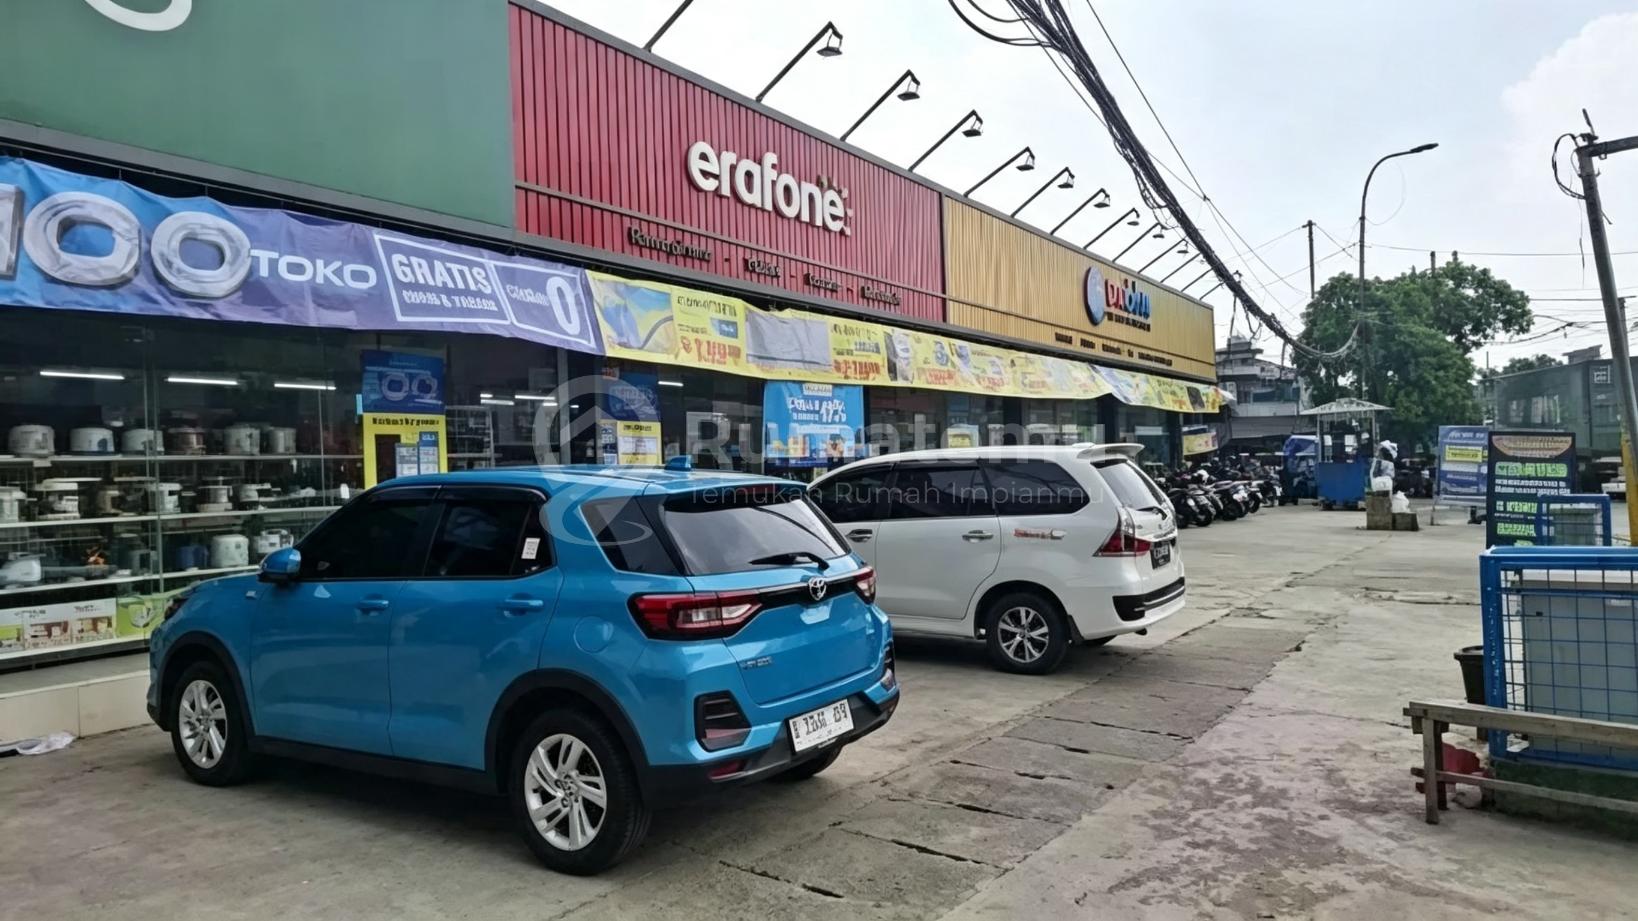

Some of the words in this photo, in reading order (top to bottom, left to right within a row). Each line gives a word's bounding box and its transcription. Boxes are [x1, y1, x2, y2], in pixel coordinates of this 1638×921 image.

[687, 141, 846, 233] erafone
[250, 248, 378, 289] TOKO
[391, 253, 493, 294] GRATIS
[546, 276, 581, 335] 0
